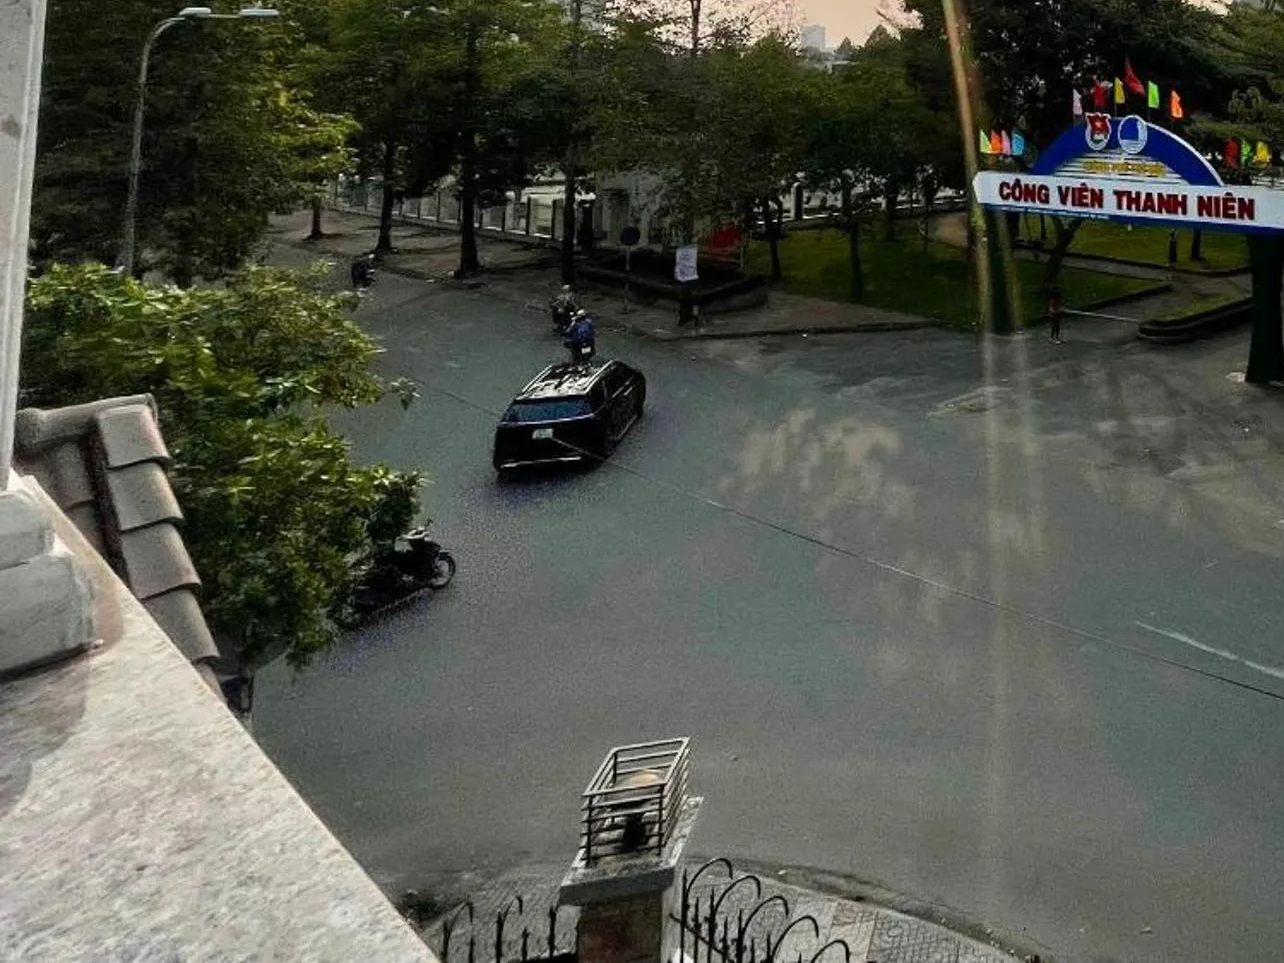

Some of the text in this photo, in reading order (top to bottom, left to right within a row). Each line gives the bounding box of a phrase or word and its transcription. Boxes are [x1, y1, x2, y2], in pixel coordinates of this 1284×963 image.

[998, 178, 1050, 205] CÔNG
[1057, 182, 1104, 208] VIÊN
[1113, 189, 1188, 216] THANH
[1197, 192, 1256, 220] NIÊN
